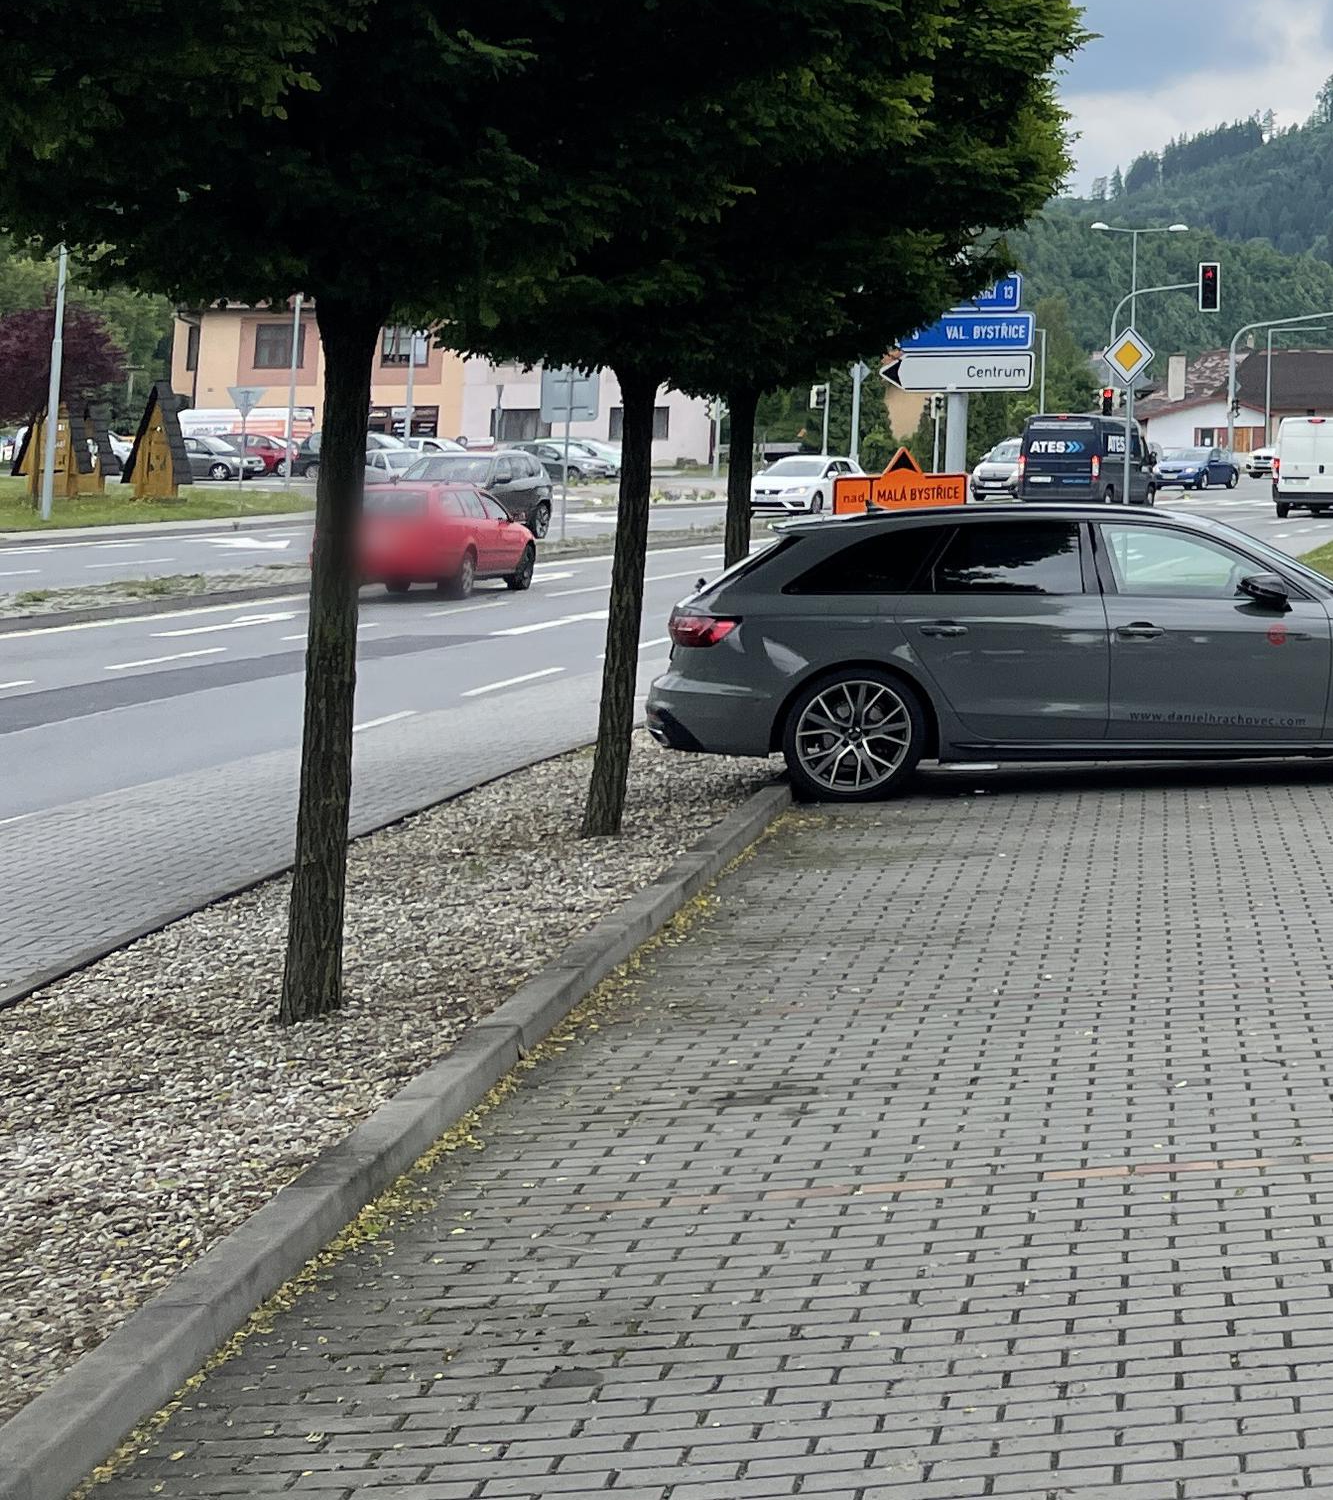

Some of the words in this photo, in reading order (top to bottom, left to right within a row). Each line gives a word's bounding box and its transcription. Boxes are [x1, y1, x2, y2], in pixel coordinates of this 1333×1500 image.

[1003, 285, 1014, 299] 13
[945, 326, 969, 340] VAL.
[973, 322, 1026, 339] BYSTŘICE
[966, 365, 1026, 378] Centrum
[1029, 440, 1066, 454] ATES
[843, 492, 865, 504] nad
[877, 487, 907, 503] MALÁ
[910, 485, 960, 501] BYSTŘICE
